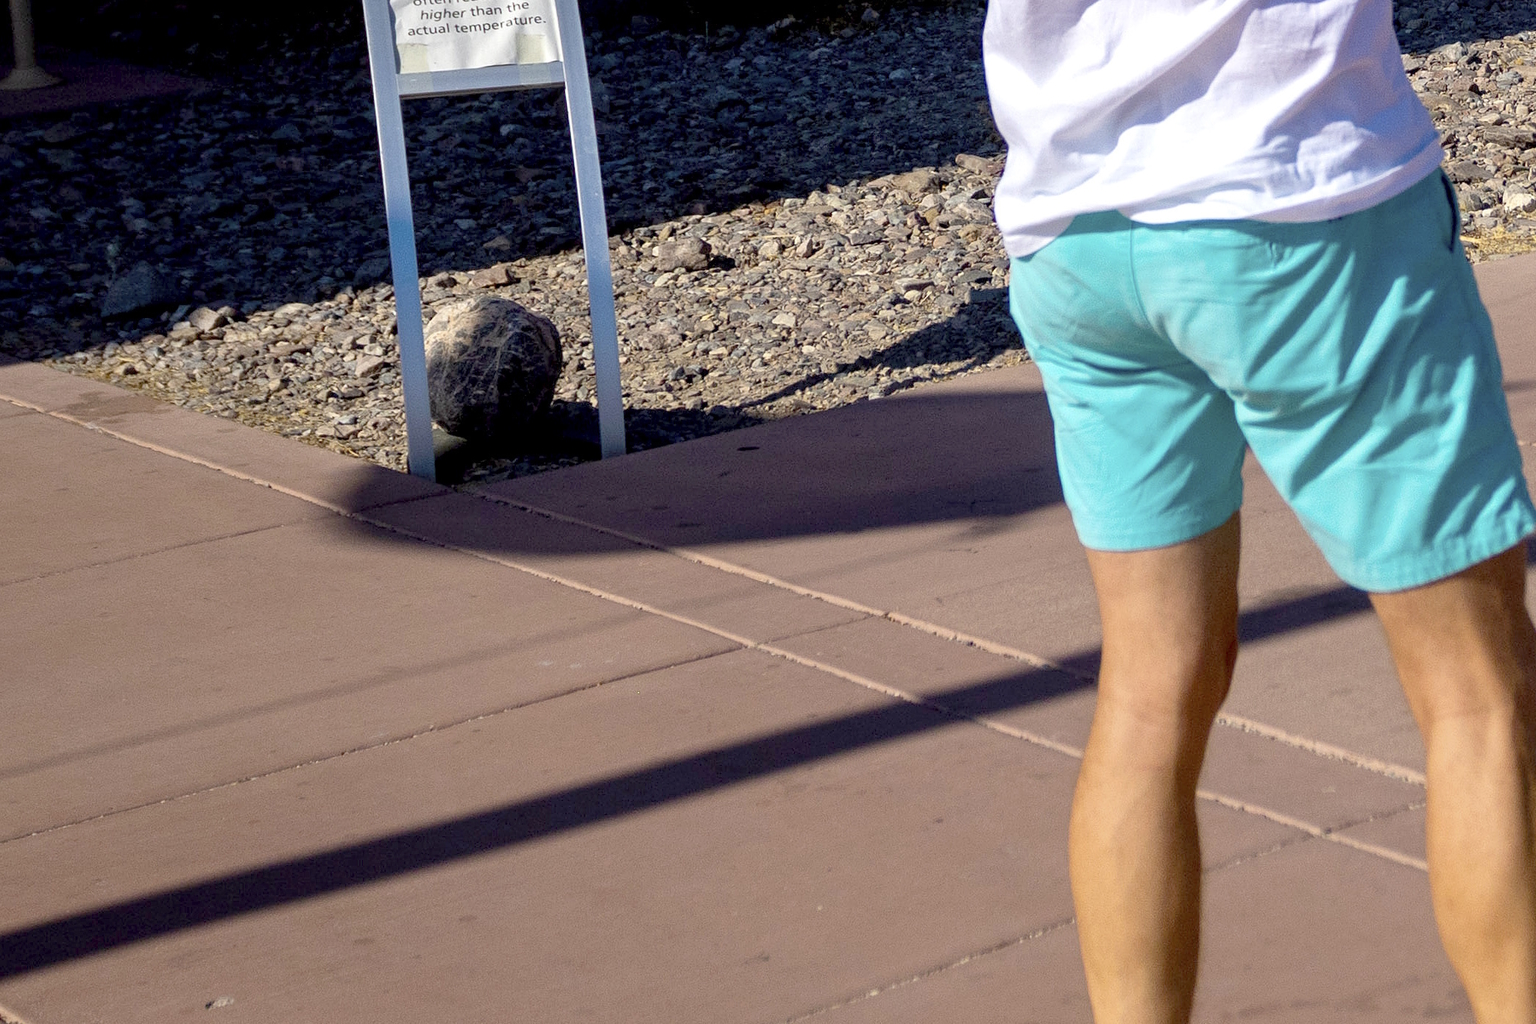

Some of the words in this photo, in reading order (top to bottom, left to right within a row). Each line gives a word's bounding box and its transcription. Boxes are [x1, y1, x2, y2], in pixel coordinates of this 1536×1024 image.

[420, 9, 467, 23] higher
[470, 5, 503, 17] than
[506, 0, 530, 14] the
[408, 24, 450, 36] actual
[454, 14, 546, 34] temperature.
